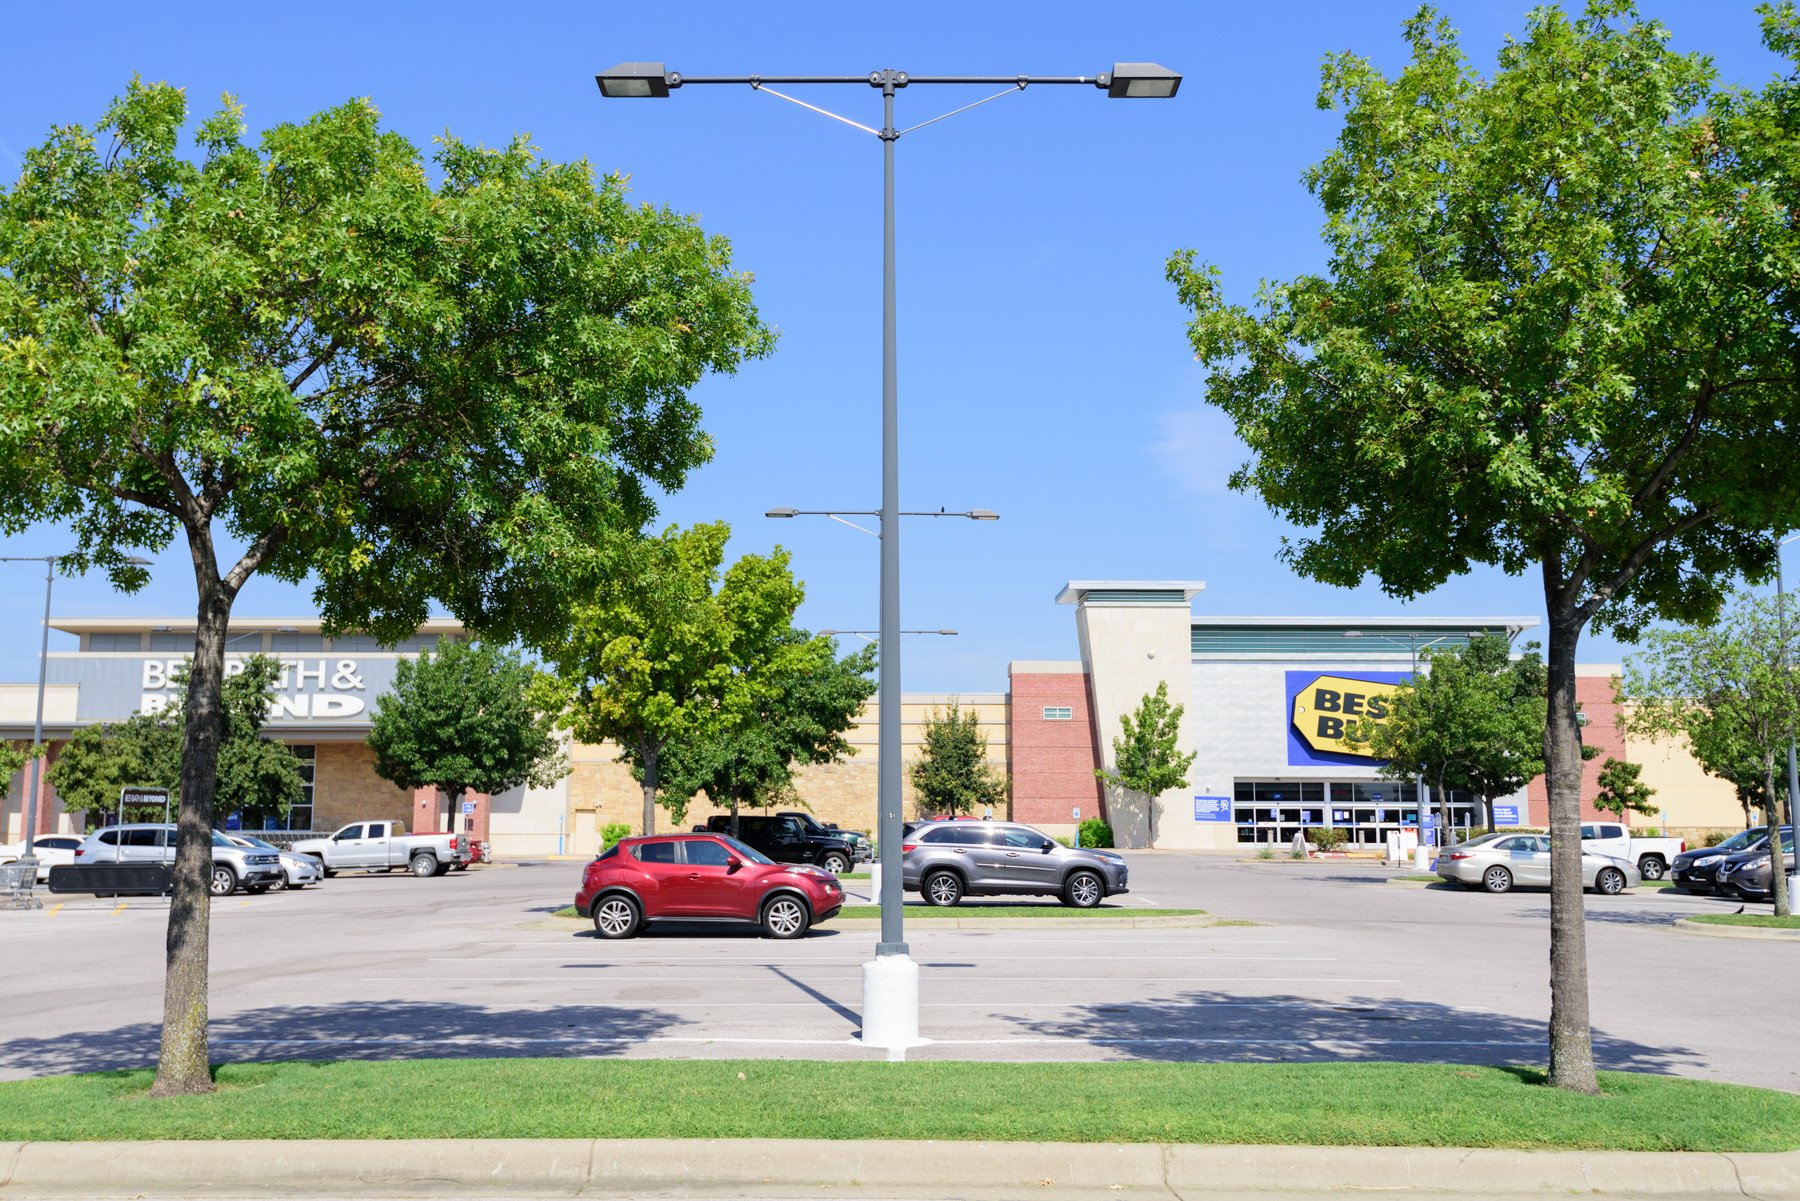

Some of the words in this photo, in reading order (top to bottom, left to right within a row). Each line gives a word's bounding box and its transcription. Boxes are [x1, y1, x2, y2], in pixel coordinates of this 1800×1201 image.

[142, 659, 191, 689] BE
[223, 659, 326, 689] BTH
[331, 659, 366, 690] &
[1314, 688, 1392, 720] BES
